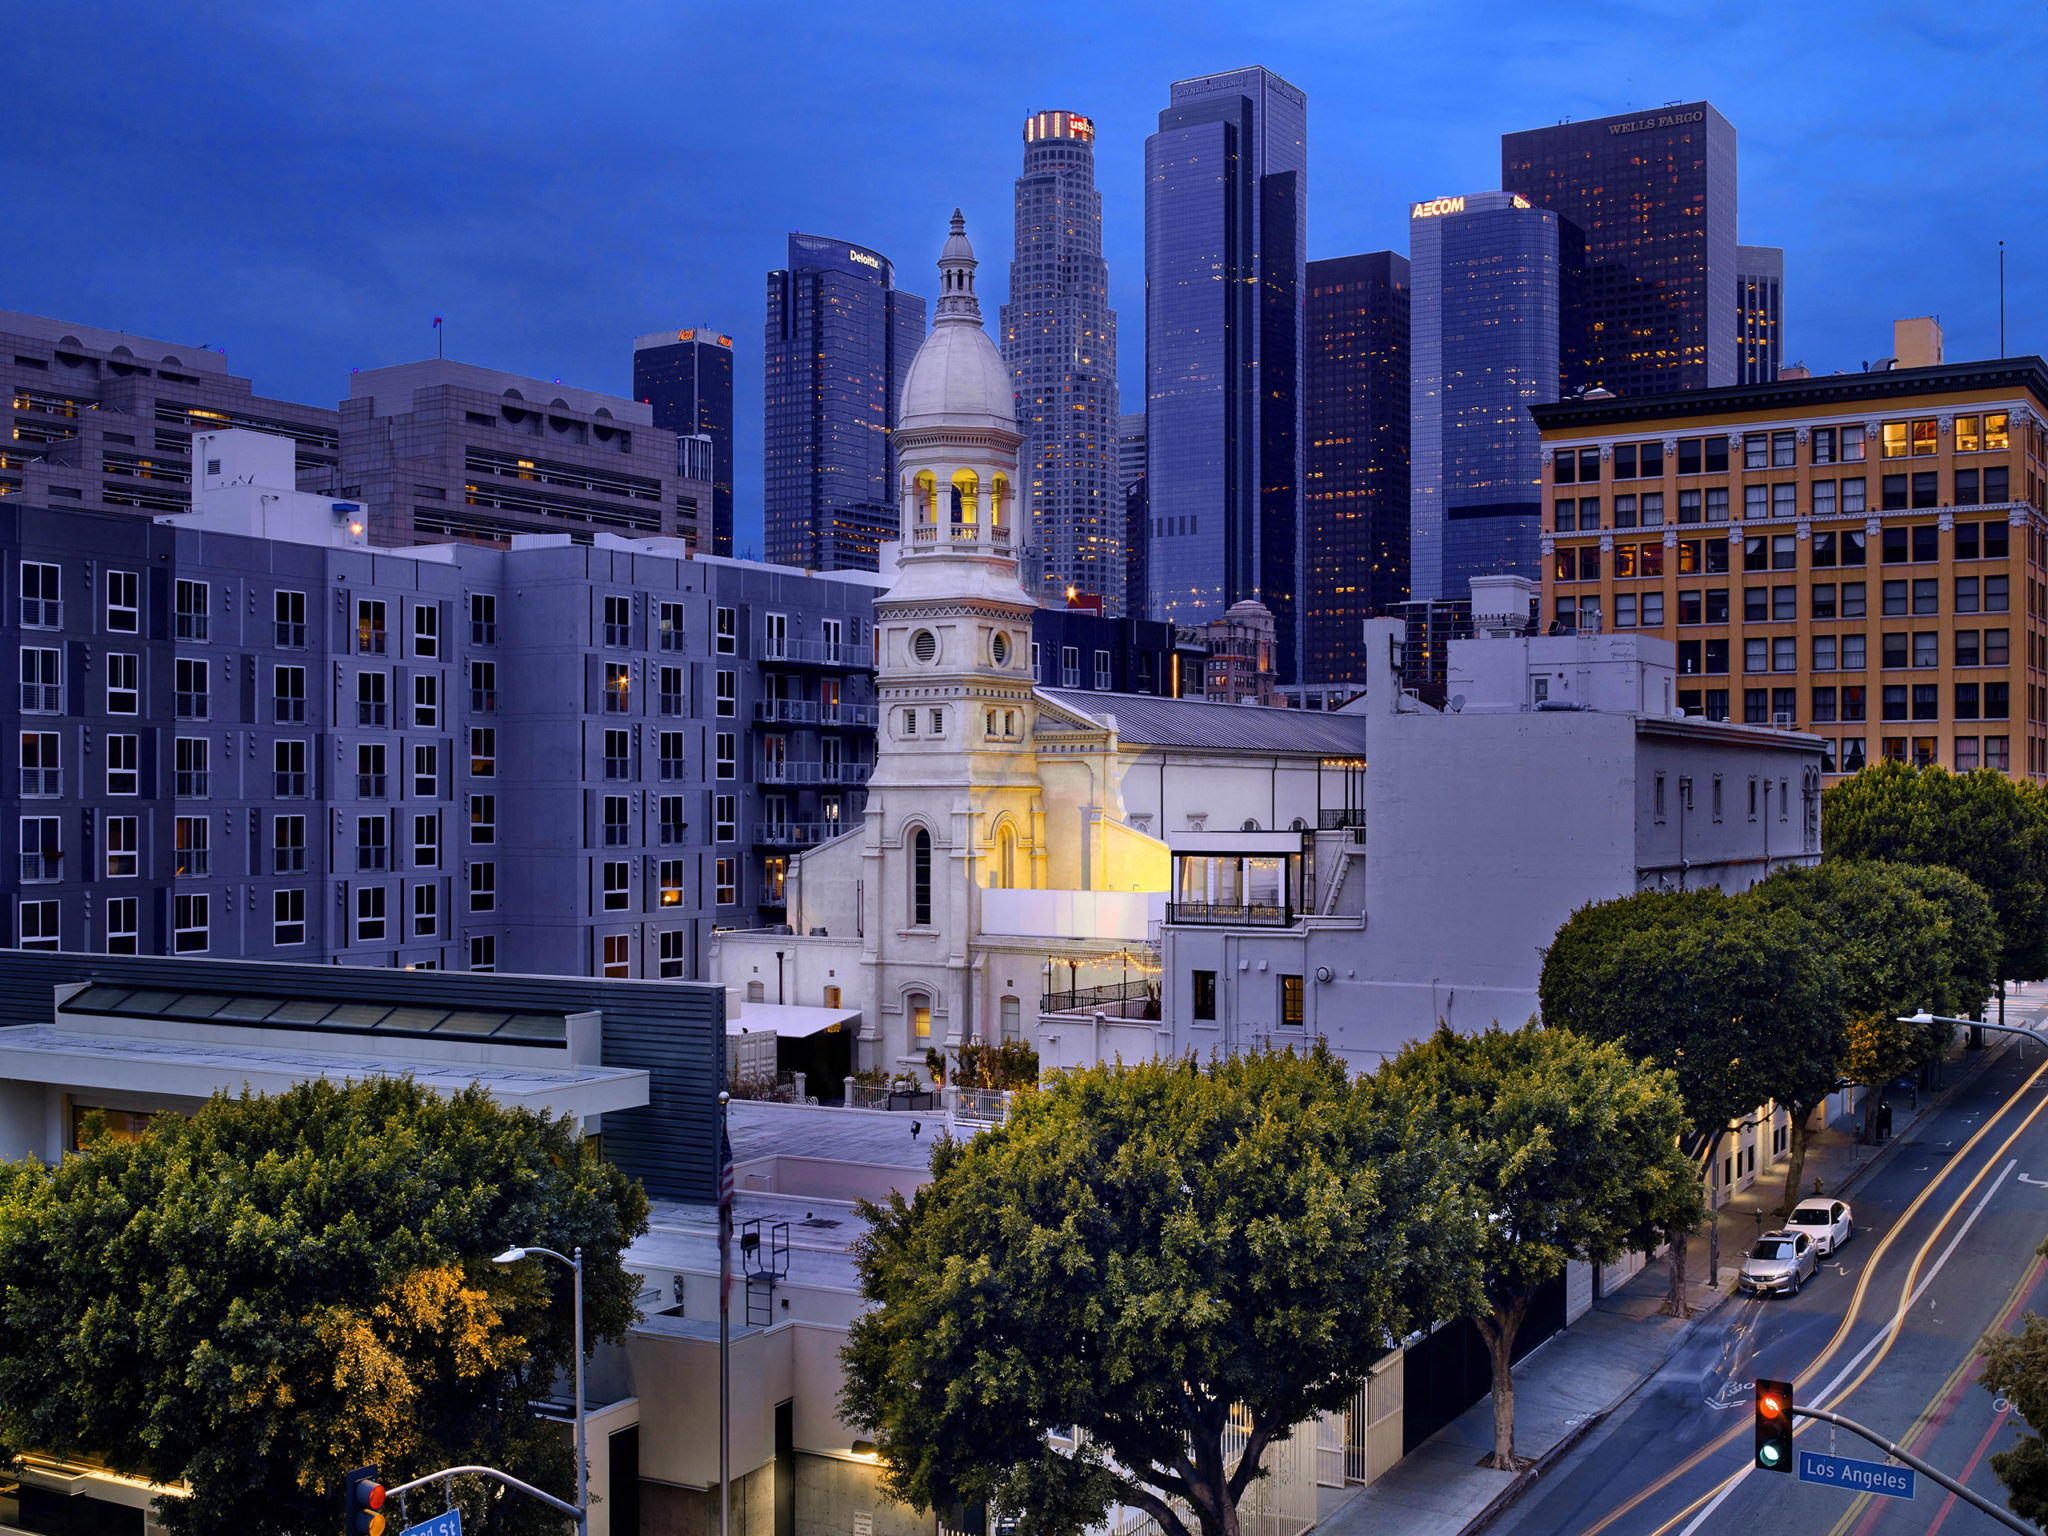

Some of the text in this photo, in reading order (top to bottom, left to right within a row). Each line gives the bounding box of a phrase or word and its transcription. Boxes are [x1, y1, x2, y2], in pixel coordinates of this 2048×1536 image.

[1609, 111, 1703, 135] WELLS FARGO
[1412, 197, 1465, 218] AECOM
[1807, 1459, 1907, 1489] Los Angeles
[439, 1520, 456, 1536] St
